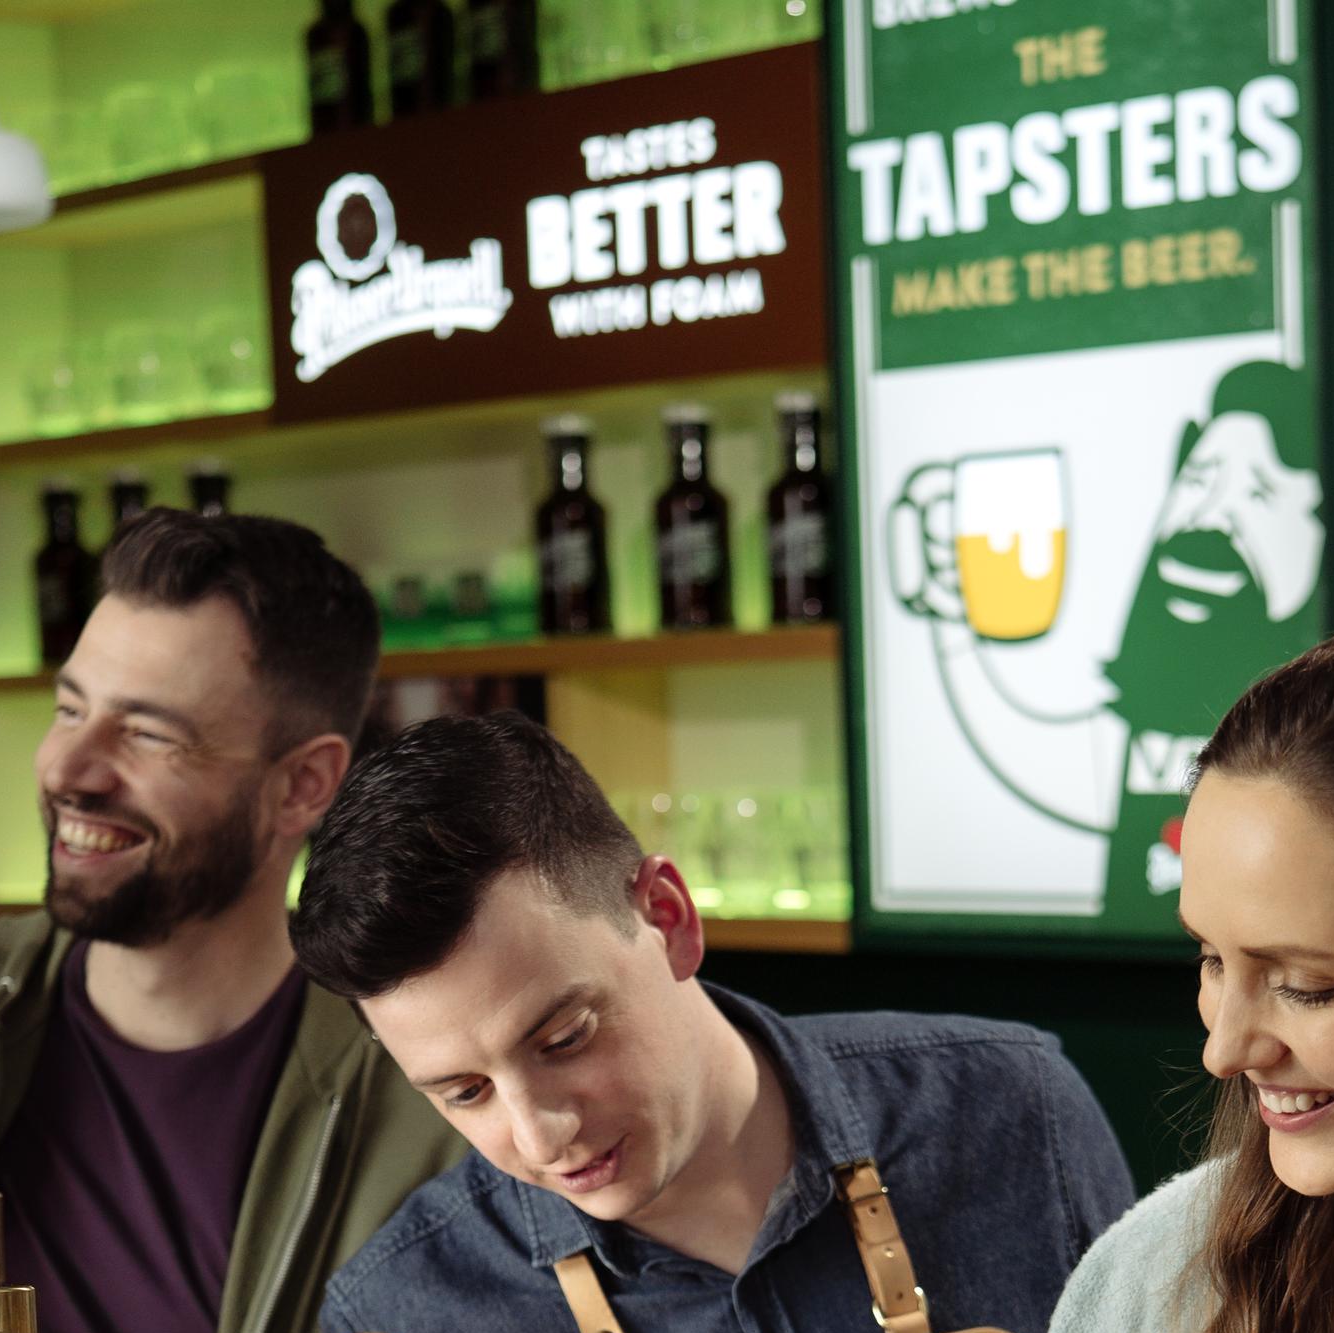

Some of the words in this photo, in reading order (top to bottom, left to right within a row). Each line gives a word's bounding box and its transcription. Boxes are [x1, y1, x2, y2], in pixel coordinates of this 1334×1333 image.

[1014, 27, 1107, 86] THE
[580, 117, 717, 181] TASTES
[847, 74, 1302, 245] TAPSTERS
[526, 160, 787, 289] BETTER
[548, 283, 647, 338] WITH
[650, 268, 765, 326] FOAM
[892, 256, 1017, 317] MAKE
[1022, 244, 1113, 300] THE
[1121, 227, 1256, 289] BEER.
